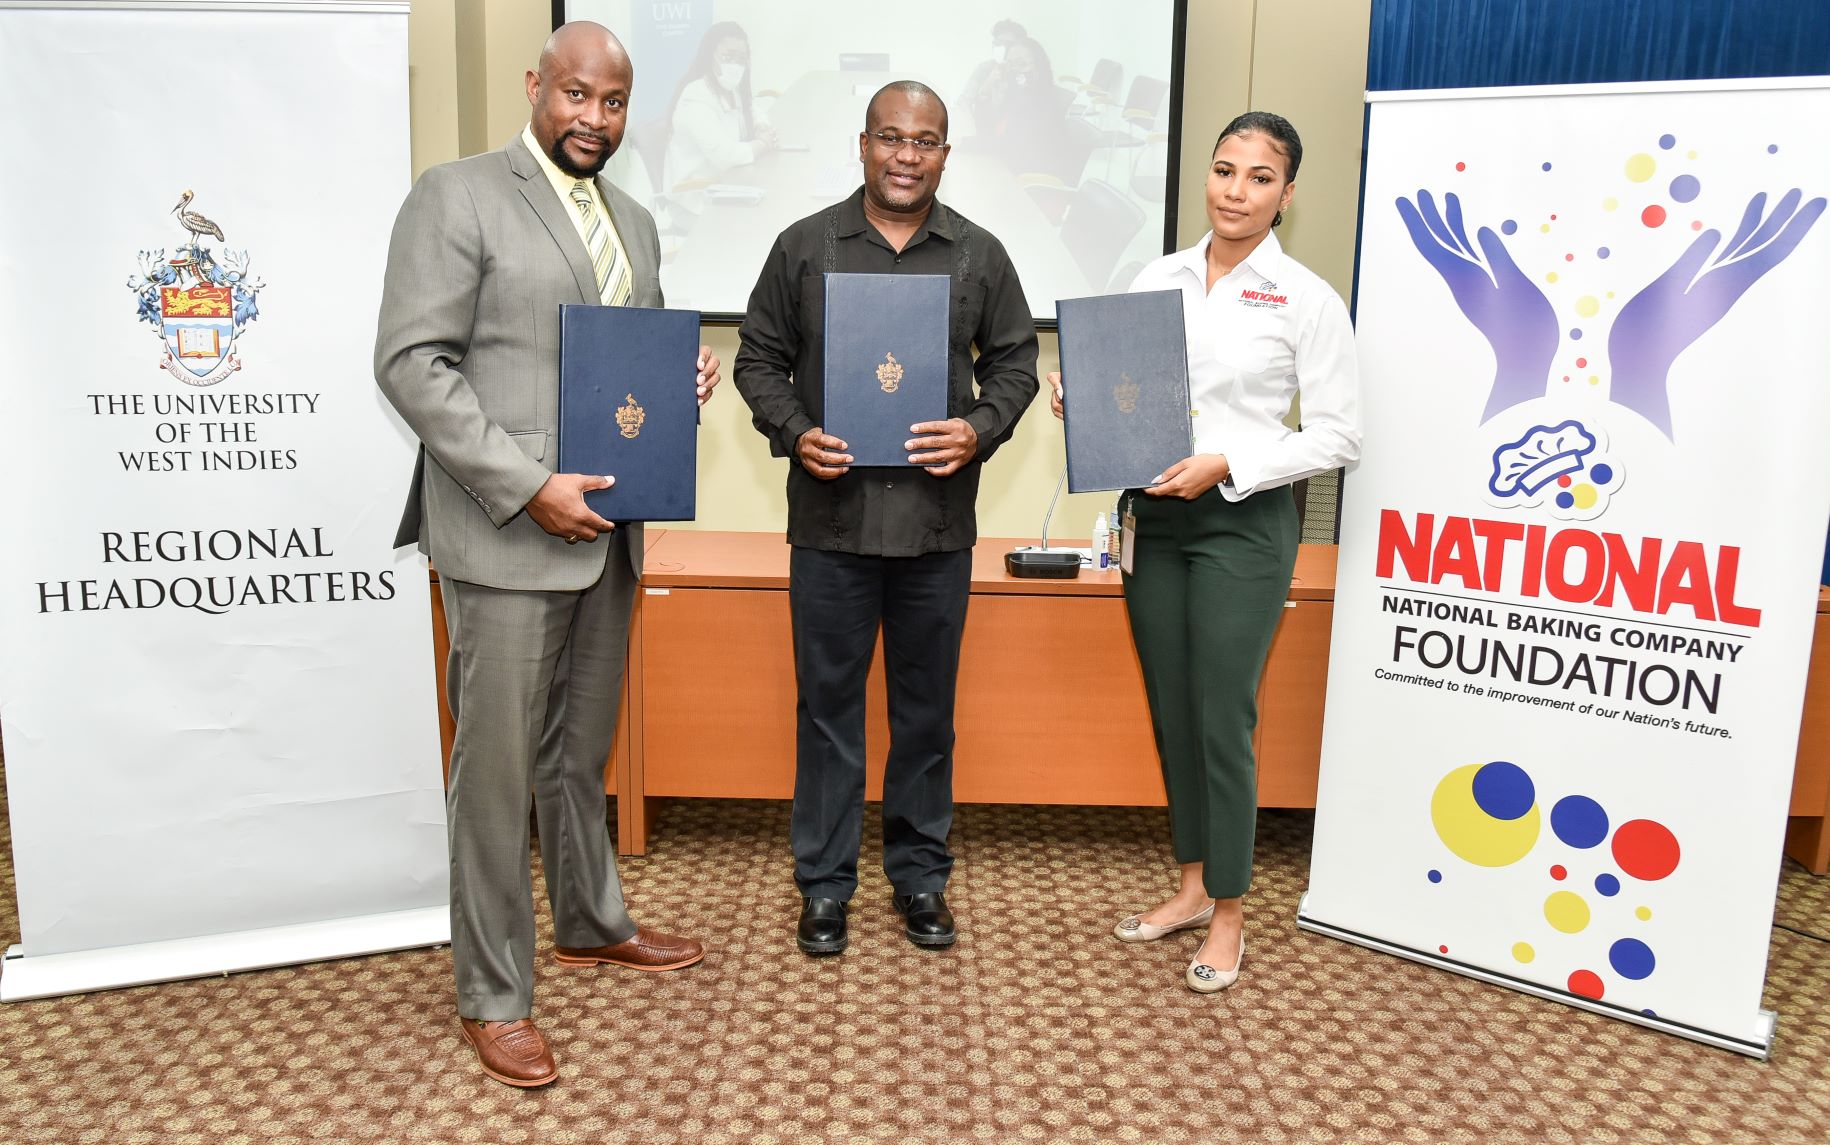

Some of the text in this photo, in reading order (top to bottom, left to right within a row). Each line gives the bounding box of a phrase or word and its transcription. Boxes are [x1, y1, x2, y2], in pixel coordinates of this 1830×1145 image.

[652, 2, 691, 21] UWI
[1241, 289, 1289, 305] NATIONAL
[87, 393, 320, 415] THE UNIVERSITY
[155, 422, 257, 444] OF THE
[118, 449, 297, 472] WEST INDIES
[101, 527, 334, 563] REGIONAL
[1375, 508, 1762, 628] NATIONAL
[35, 570, 396, 615] HEADQUARTERS
[1382, 595, 1744, 663] NATIONAL BAKING COMPANY
[1393, 625, 1722, 715] FOUNDATION
[1374, 668, 1733, 739] Committed to the improvement of our Nation's future.
